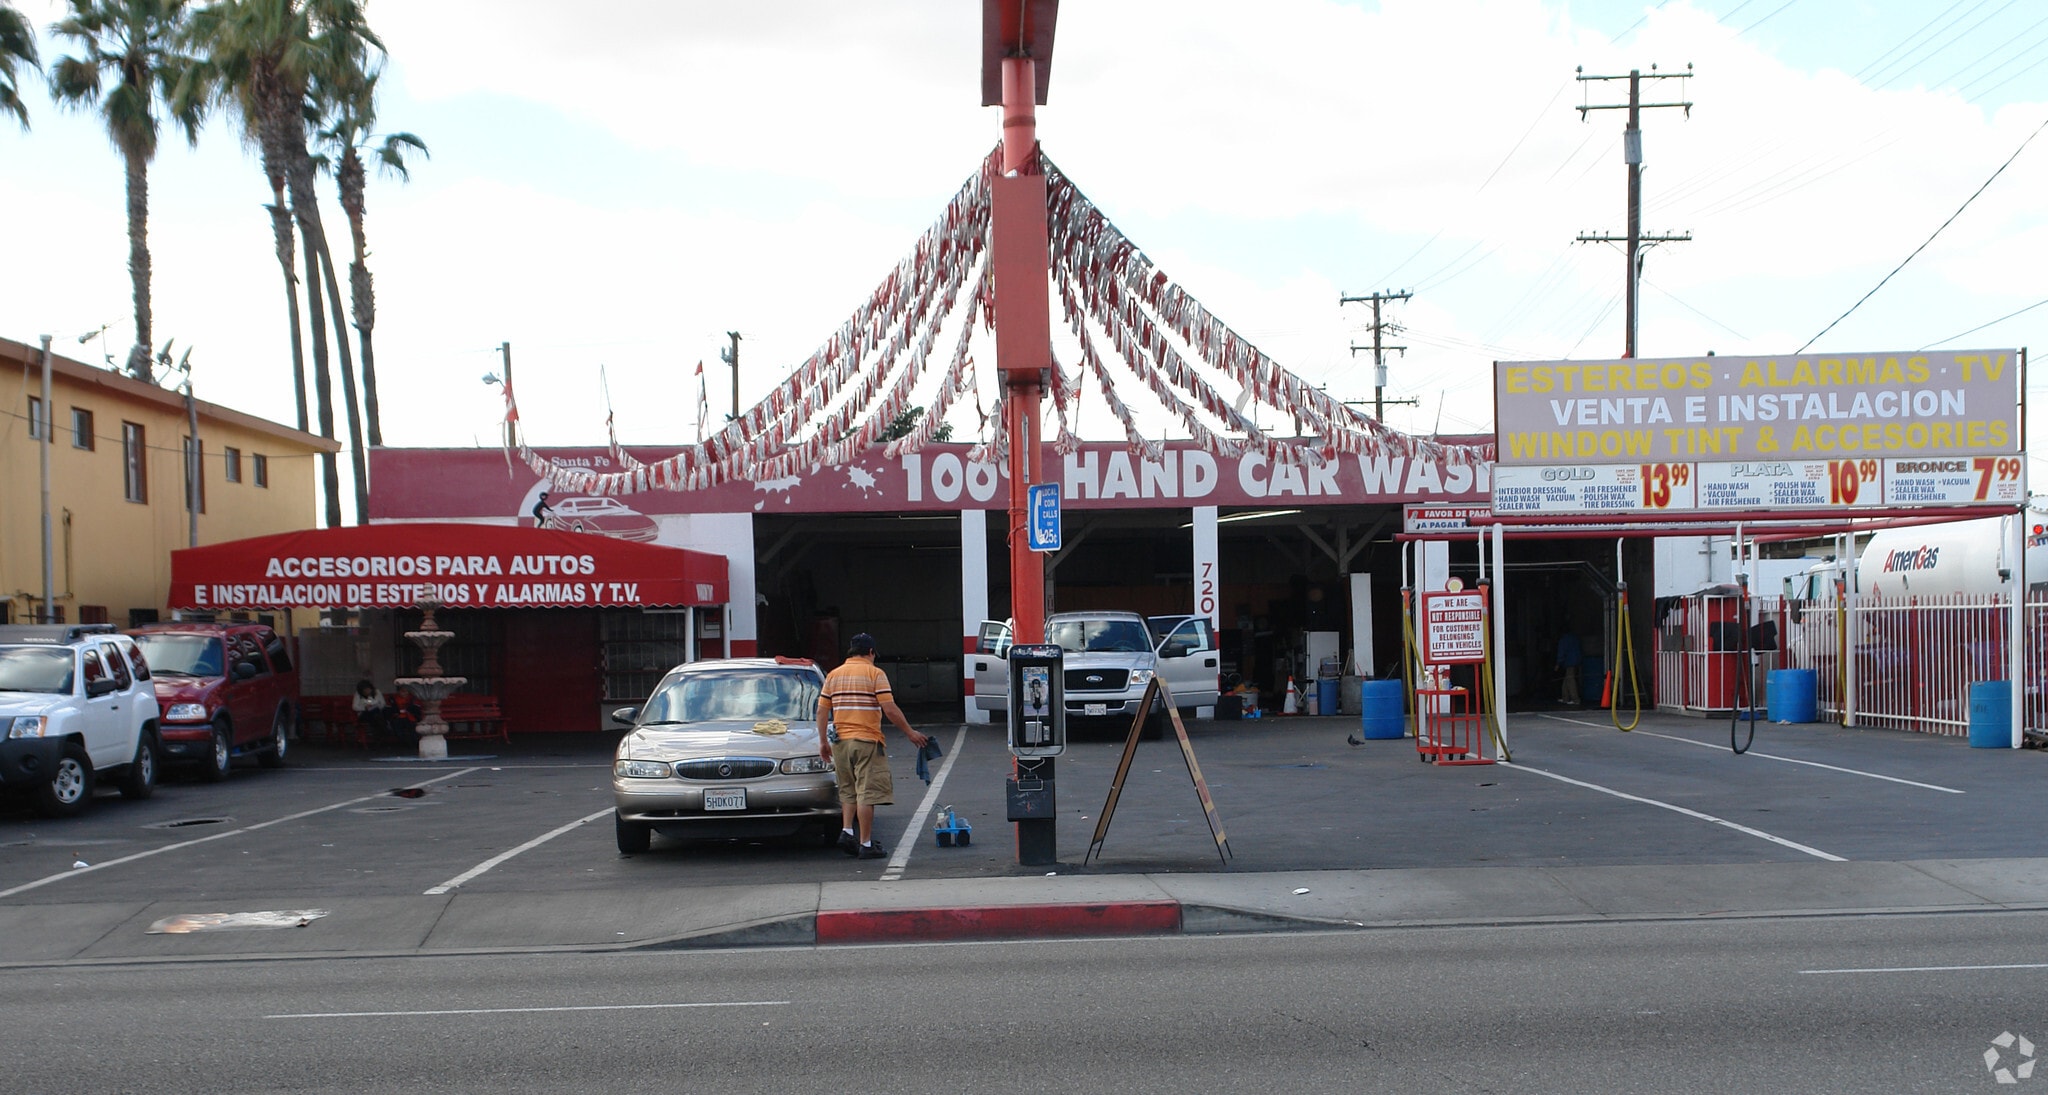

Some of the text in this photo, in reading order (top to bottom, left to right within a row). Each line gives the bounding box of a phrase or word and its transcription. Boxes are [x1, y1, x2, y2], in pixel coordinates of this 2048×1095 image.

[1506, 355, 2009, 394] ESTEREOS ALARMAS TV
[1550, 389, 1966, 426] VENTA E INSTALACION
[1508, 420, 2009, 460] WINDOW TINT & ACCESORIES
[551, 455, 610, 467] Santa Fe
[1730, 462, 1794, 477] PLATA
[1896, 461, 1968, 474] BRONCE
[902, 452, 1010, 503] 100
[1063, 450, 1218, 499] HAND
[1238, 451, 1341, 498] CAR
[1541, 467, 1596, 481] GOLD
[1707, 482, 1749, 490] HAND WASH
[1774, 481, 1816, 489] POLISH WAX
[1895, 477, 1971, 486] HAND WASH VACUUM
[1498, 486, 1567, 495] INTERIOR DRESSING
[1583, 485, 1637, 493] AIR FRESHENER
[1774, 488, 1816, 497] SEALER WAX
[1921, 485, 1935, 493] WAX
[1498, 493, 1576, 502] HAND WASH VACUUM
[1583, 493, 1610, 501] POLISH
[1707, 490, 1737, 498] VACUUM
[1895, 493, 1946, 501] AIR FRESHENER
[1044, 499, 1055, 508] COIN
[1600, 500, 1635, 508] DRESSING
[1707, 497, 1761, 506] AIR FRESHENER
[1774, 495, 1825, 504] TIRE DRESSING
[1498, 502, 1523, 510] SEALER
[1042, 510, 1057, 519] CALLS
[1424, 509, 1492, 518] FAVOR DE PASA
[1430, 521, 1459, 529] PAGAR
[1883, 544, 1939, 574] AmeriGas
[266, 554, 595, 579] ACCESORIOS PARA AUTOS
[195, 584, 207, 605] E
[213, 584, 341, 605] INSTALACION
[347, 583, 372, 604] DE
[474, 582, 488, 604] Y
[495, 582, 585, 603] ALARMAS
[590, 582, 604, 603] Y
[609, 582, 640, 603] T.V.
[1456, 599, 1468, 607] ARE
[1432, 611, 1480, 621] NOT RESPONSIBLE
[706, 796, 744, 808] 5HDK077
